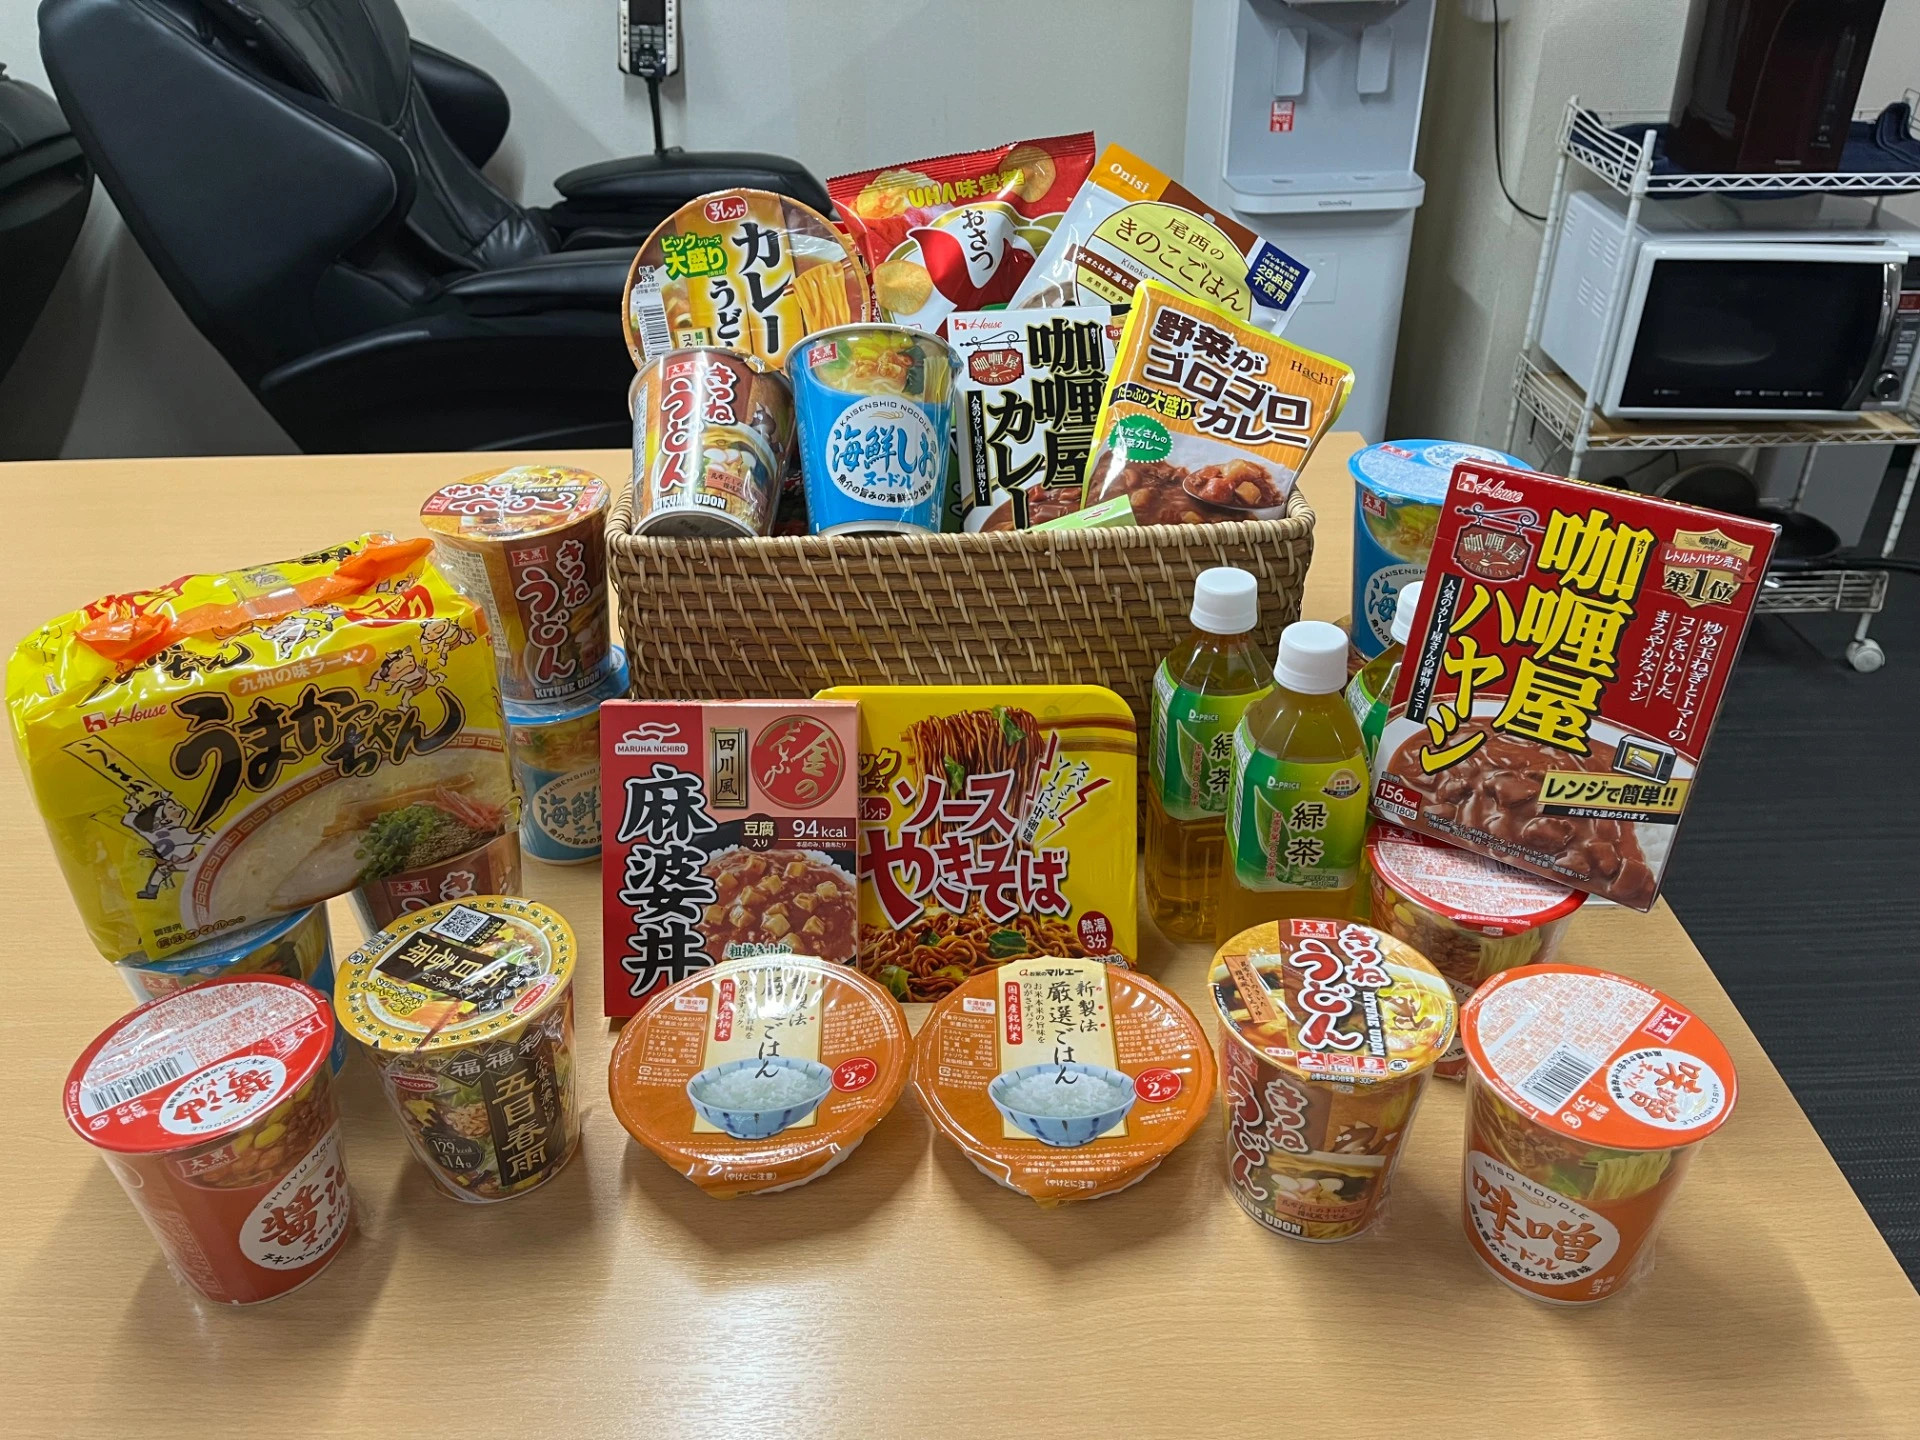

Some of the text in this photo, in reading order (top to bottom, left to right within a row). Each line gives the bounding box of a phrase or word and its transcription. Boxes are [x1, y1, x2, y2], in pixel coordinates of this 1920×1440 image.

[1109, 163, 1150, 194] Onisi
[665, 247, 724, 276] 大盛り
[962, 209, 995, 272] おさつ
[1115, 217, 1245, 312] きのこごはん
[1164, 217, 1225, 260] 尾西の
[732, 222, 791, 354] カレー
[1253, 272, 1287, 304] 不使用
[1257, 264, 1293, 292] 28品目
[710, 280, 742, 347] うど
[968, 317, 1003, 331] House
[1150, 308, 1267, 374] 野菜が
[703, 362, 736, 424] きつね
[1146, 348, 1309, 428] ゴロゴロ
[1290, 360, 1335, 386] Hachi
[660, 378, 704, 492] うどん
[832, 424, 937, 480] 海鮮しお
[1196, 405, 1309, 447] カレー
[863, 472, 914, 489] ヌードル
[987, 390, 1044, 529] カレー
[695, 494, 726, 509] UDON
[1477, 478, 1523, 502] House
[556, 540, 591, 607] きつね
[1636, 539, 1646, 563] カリー
[1665, 550, 1743, 571] レトルトハヤシ売上
[1662, 568, 1735, 604] 第1位
[515, 567, 577, 683] うどん
[238, 649, 368, 693] 九州の味ラーメン
[1421, 584, 1504, 774] ハヤシ
[1629, 610, 1671, 702] まろやかなハヤシ
[1656, 615, 1696, 699] コクをいかした
[1668, 621, 1723, 741] 炒め玉ねぎとトマトの
[109, 704, 168, 727] House
[534, 682, 576, 700] KITUNE
[172, 684, 465, 833] うまかっちゃん
[617, 745, 685, 753] MARUHA NICHIRO
[717, 737, 738, 797] 四川風
[895, 769, 1020, 846] ソース
[1048, 761, 1090, 820] スパイシーな
[744, 822, 774, 837] 豆腐
[752, 838, 769, 848] 入り
[792, 819, 848, 839] 94 kcal
[1287, 802, 1328, 866] 緑茶
[617, 762, 718, 998] 麻婆丼
[860, 827, 1072, 930] やきそば
[1081, 918, 1107, 932] 熱湯
[1086, 934, 1107, 949] 3分
[1299, 923, 1329, 933] 大黒
[1338, 923, 1392, 988] きつね
[1007, 984, 1021, 1042] 国内産銘柄米
[1033, 983, 1046, 1044] お米本来の旨味を
[1076, 980, 1099, 1033] 新製法
[1289, 938, 1364, 1050] うどん
[1362, 991, 1380, 1030] KITUNE
[1047, 982, 1079, 1085] 厳選ごはん
[173, 1069, 276, 1124] 醤油
[844, 1072, 867, 1088] 2分
[1147, 1082, 1173, 1097] 2分
[1628, 1060, 1703, 1123] 味噌
[492, 1068, 547, 1178] 五目春雨
[1265, 1078, 1308, 1153] きつね
[1472, 1166, 1602, 1264] 味噌
[1484, 1160, 1589, 1220] MISO NOODLE
[1265, 1214, 1302, 1235] UDON
[1490, 1227, 1560, 1271] ヌードル
